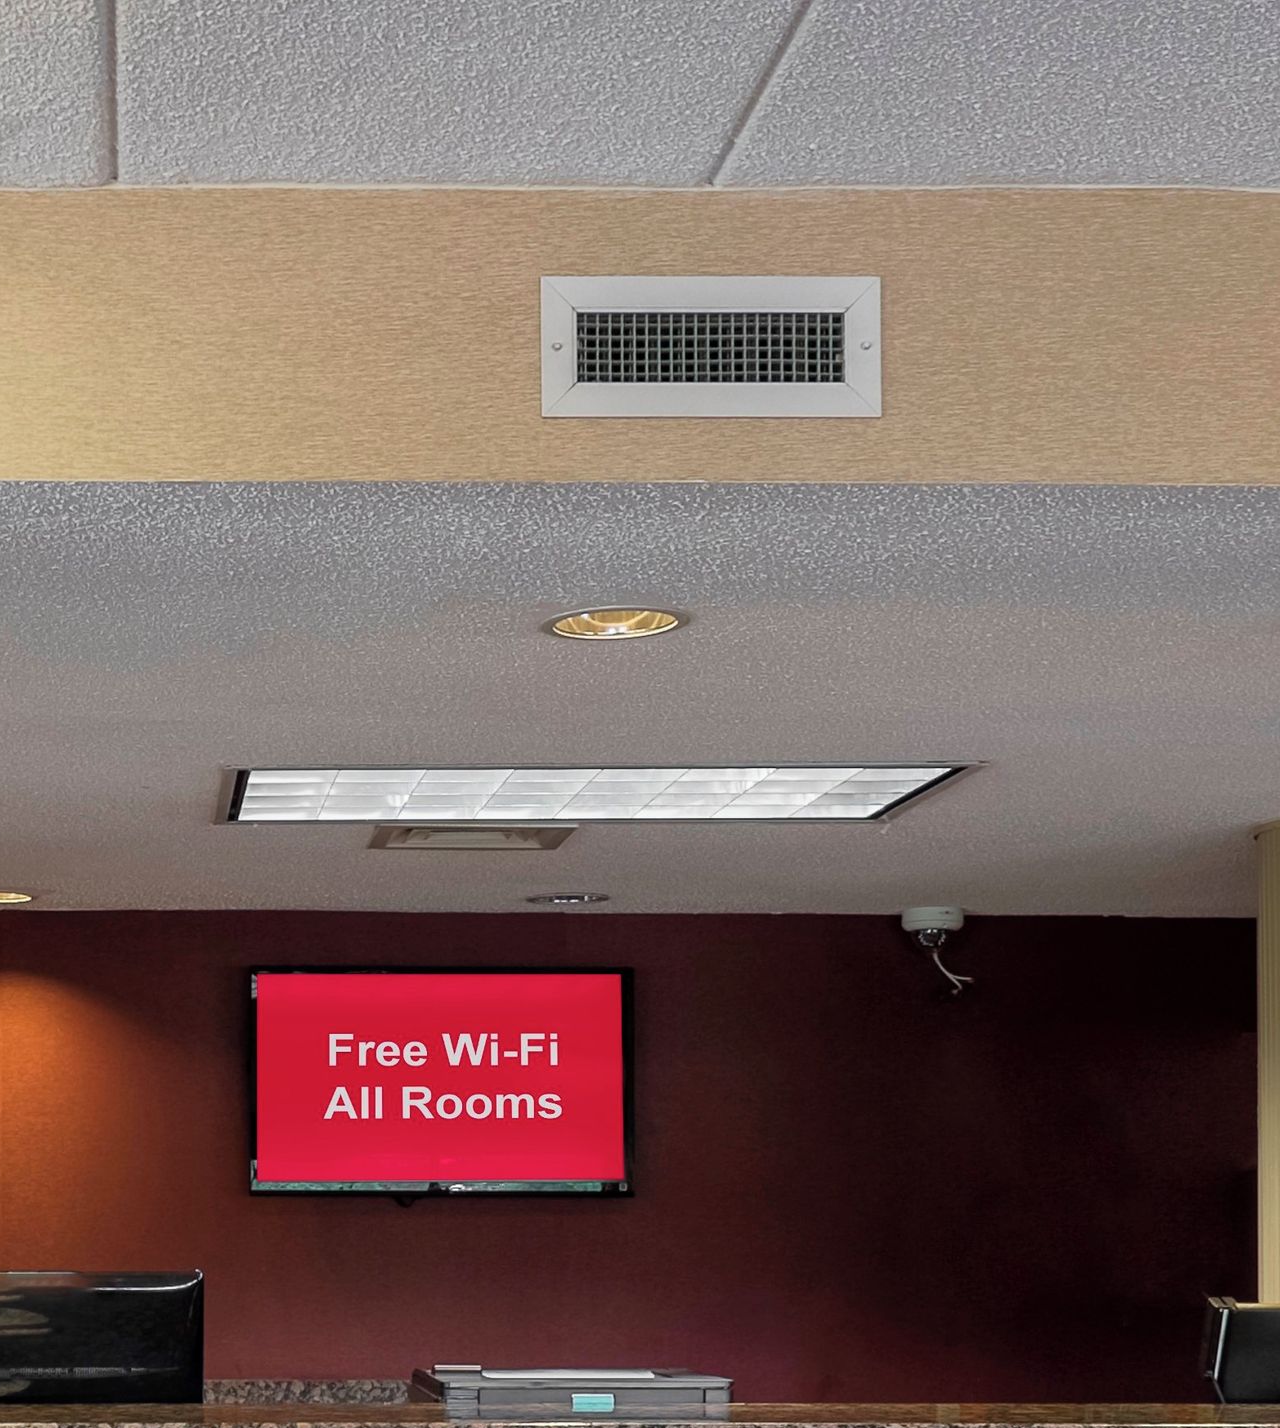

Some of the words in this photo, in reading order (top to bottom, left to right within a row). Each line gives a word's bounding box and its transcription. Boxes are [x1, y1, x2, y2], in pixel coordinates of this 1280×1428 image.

[328, 1033, 428, 1067] Free
[441, 1033, 560, 1067] Wi-Fi
[323, 1086, 383, 1120] All
[401, 1086, 563, 1120] Rooms
